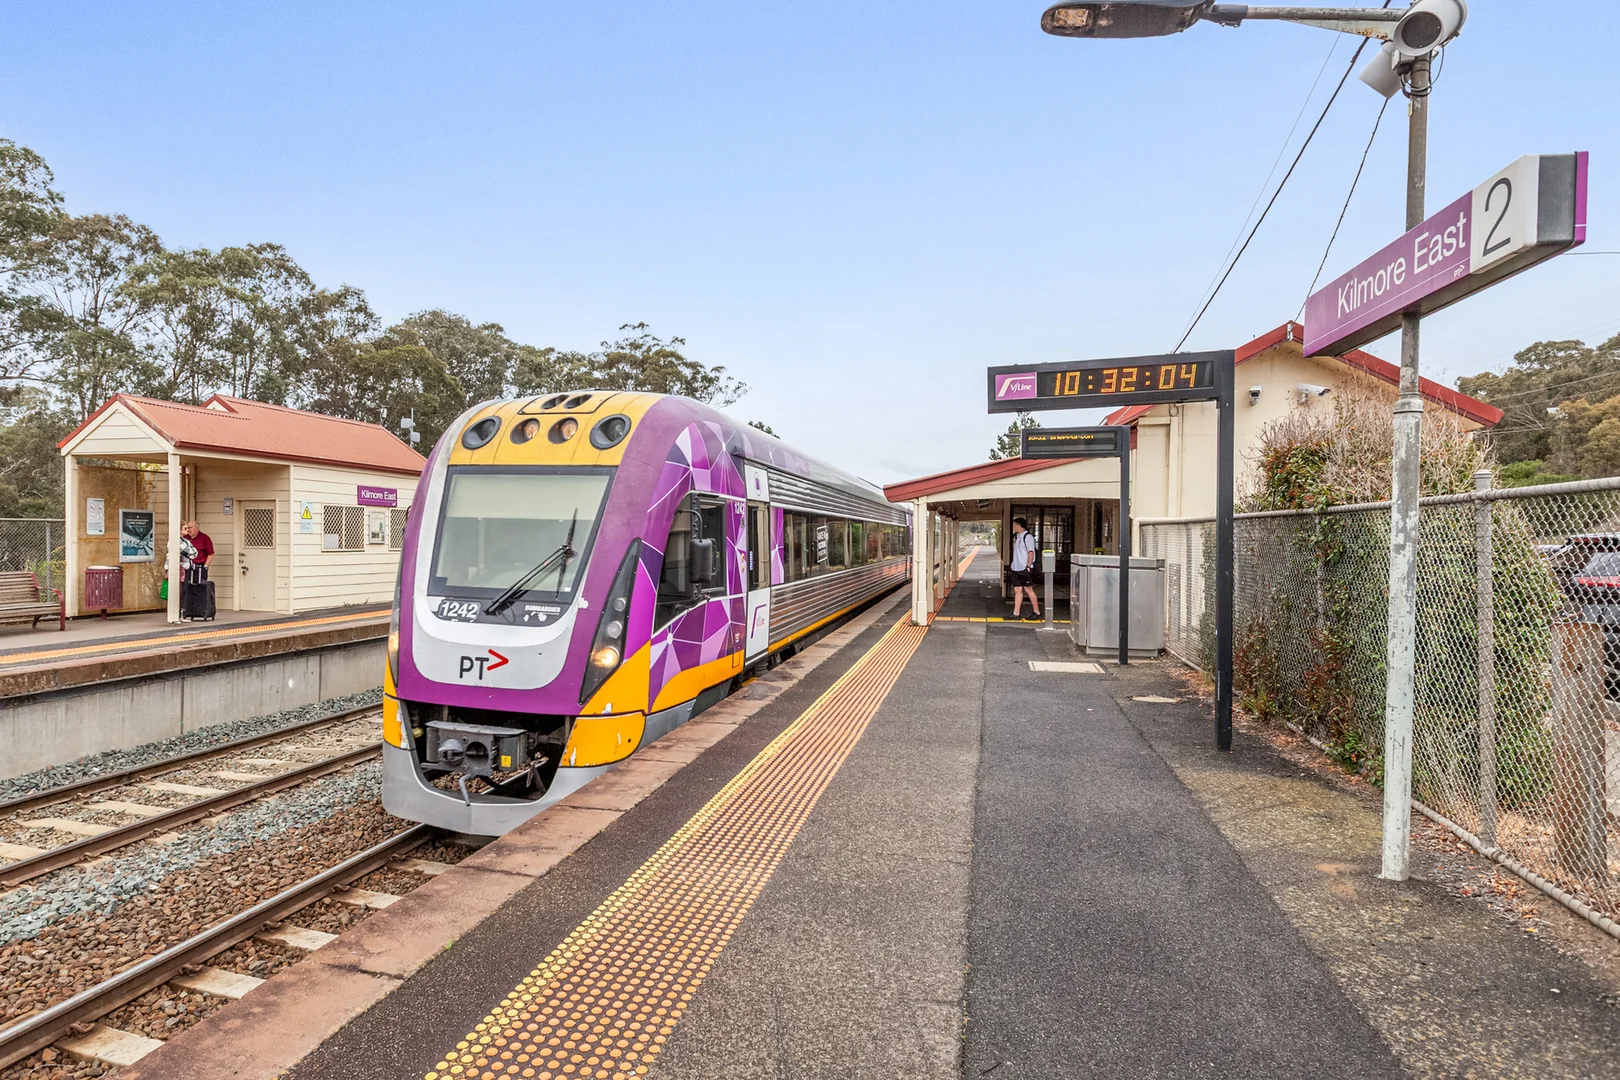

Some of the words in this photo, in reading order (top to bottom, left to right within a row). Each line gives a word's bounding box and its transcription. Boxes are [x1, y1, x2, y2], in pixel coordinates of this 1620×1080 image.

[1482, 177, 1512, 257] 2
[1337, 257, 1406, 318] Kilmore
[1413, 211, 1467, 275] East
[361, 490, 383, 500] Kilmore
[384, 491, 397, 501] East
[442, 602, 478, 618] 1242
[459, 655, 490, 681] PT
